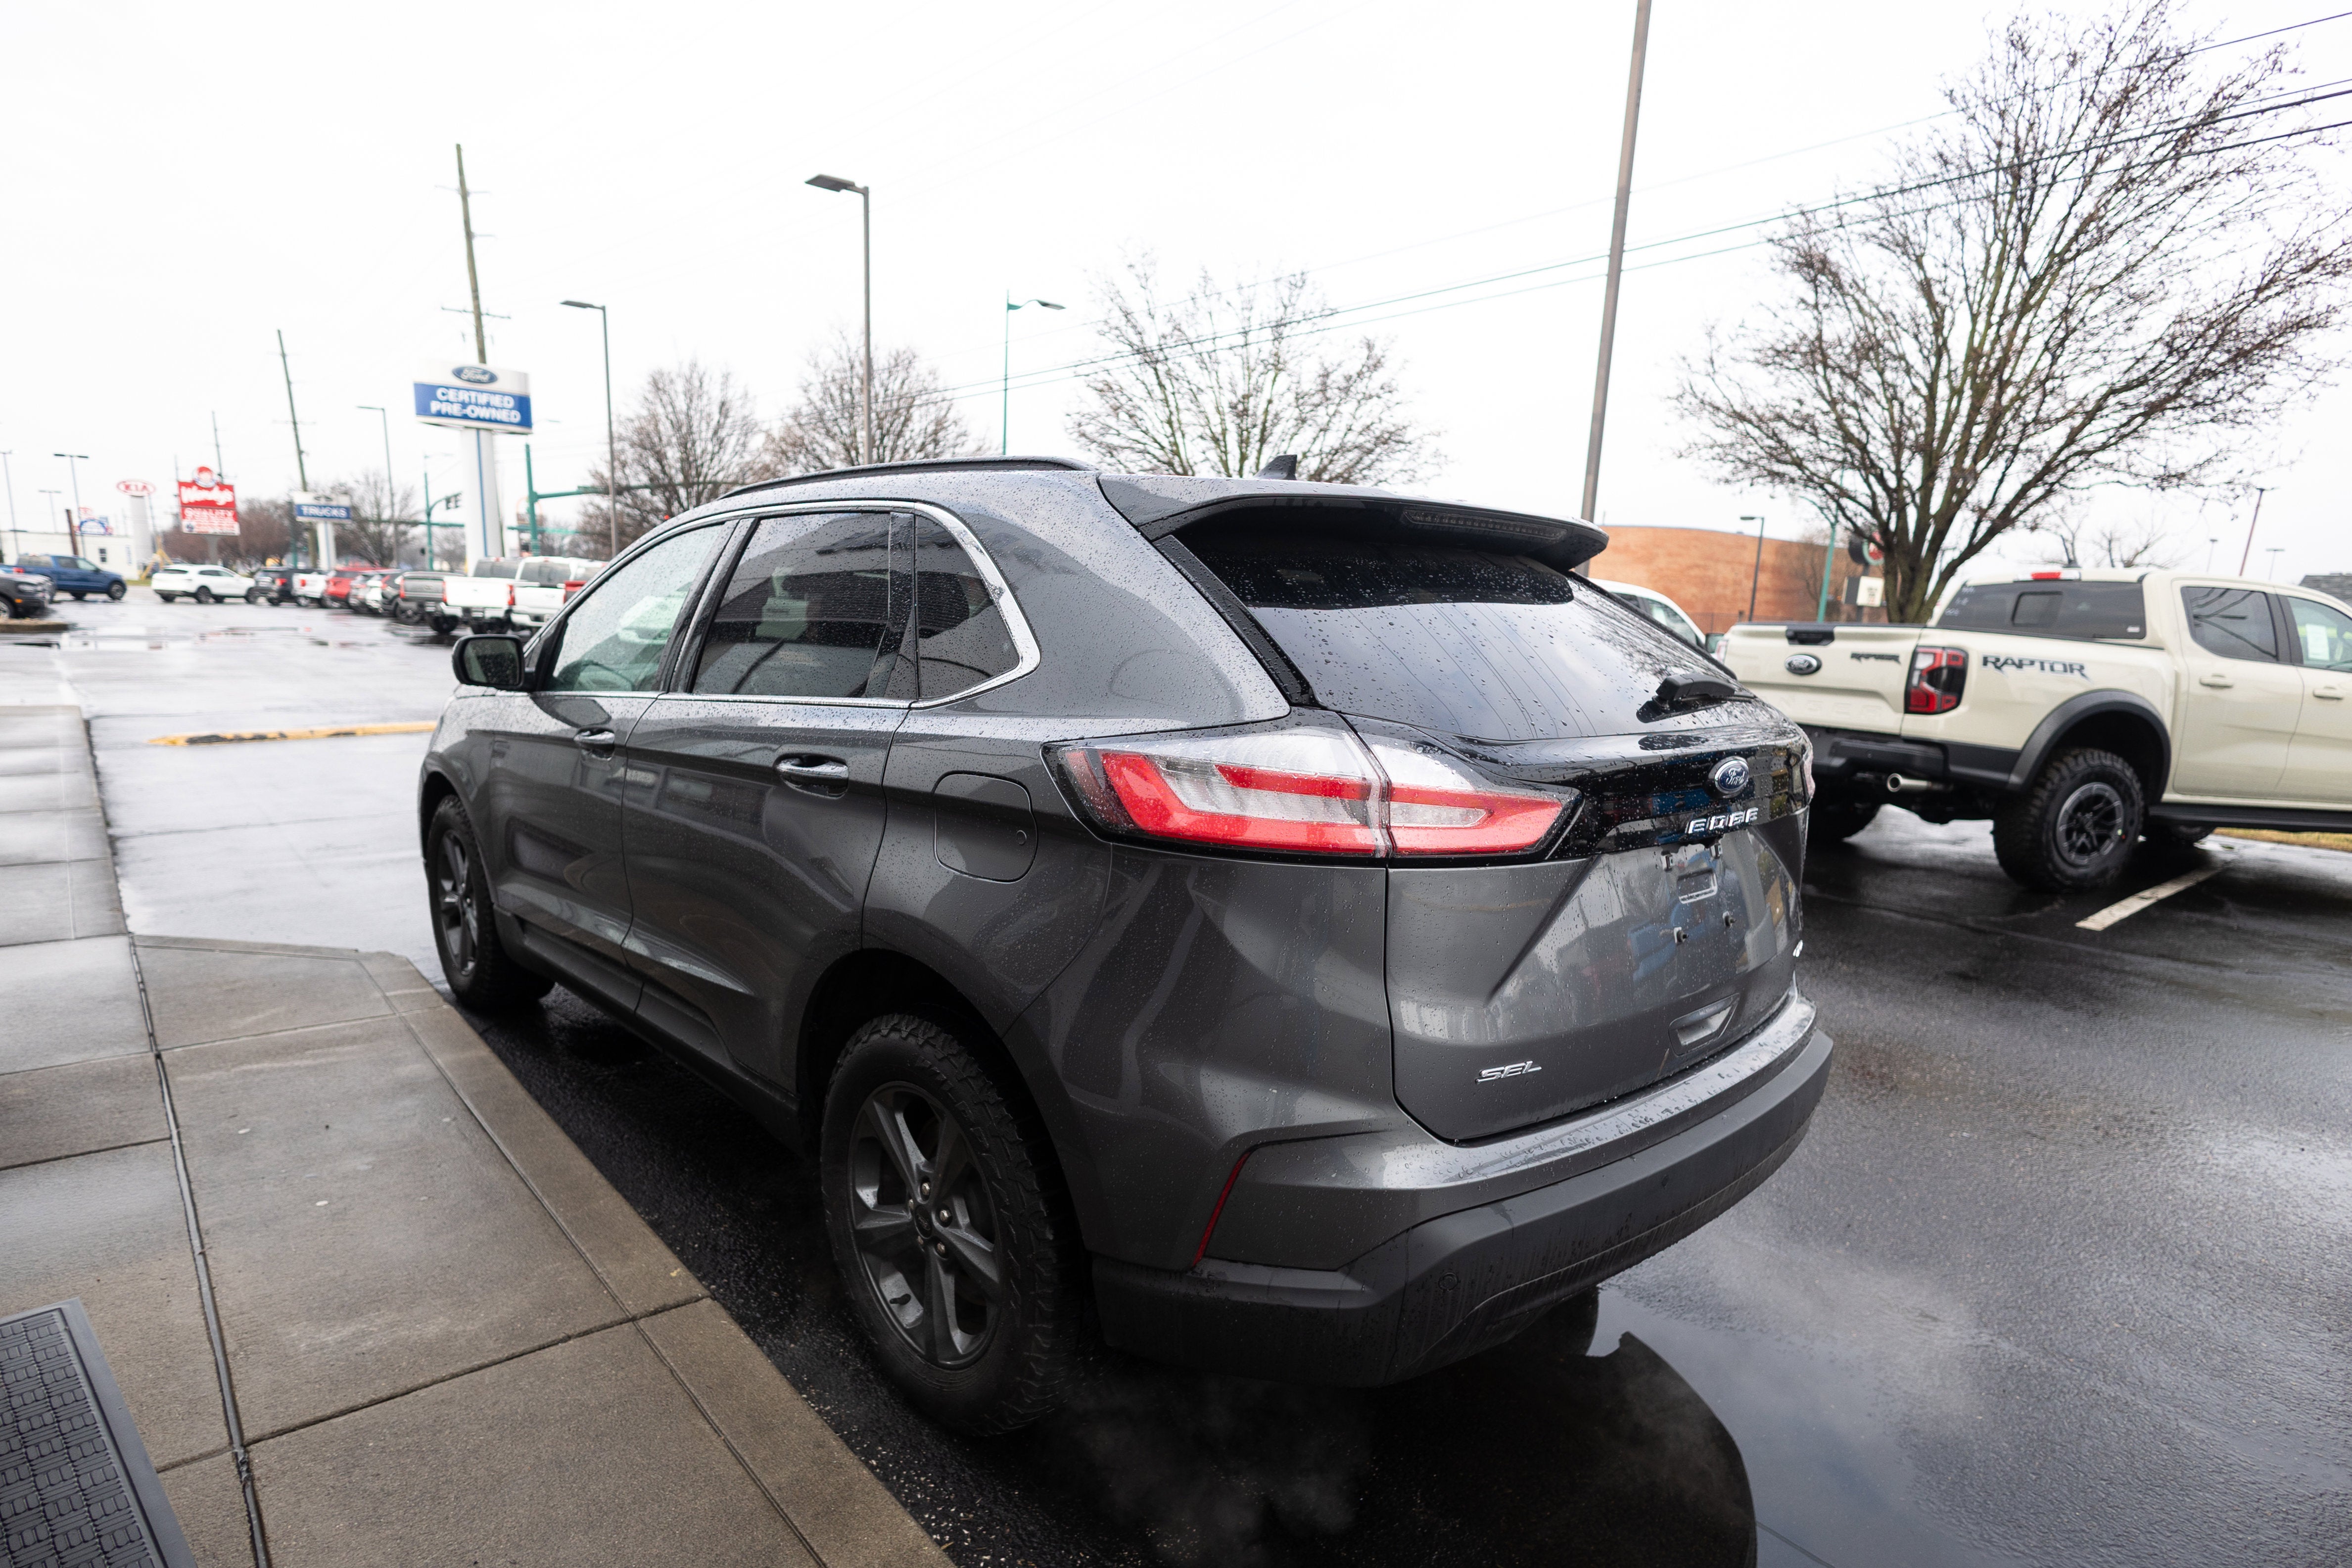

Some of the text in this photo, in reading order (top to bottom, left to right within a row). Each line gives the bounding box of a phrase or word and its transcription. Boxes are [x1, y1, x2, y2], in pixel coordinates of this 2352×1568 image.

[436, 387, 515, 409] CERTIFIED
[430, 401, 521, 423] PRE-OWNED
[180, 485, 234, 506] Wendy's
[301, 505, 347, 518] TRUCKS
[1981, 655, 2093, 684] RAPTOR
[1685, 807, 1758, 834] EDGE
[1475, 1060, 1542, 1084] SEL
